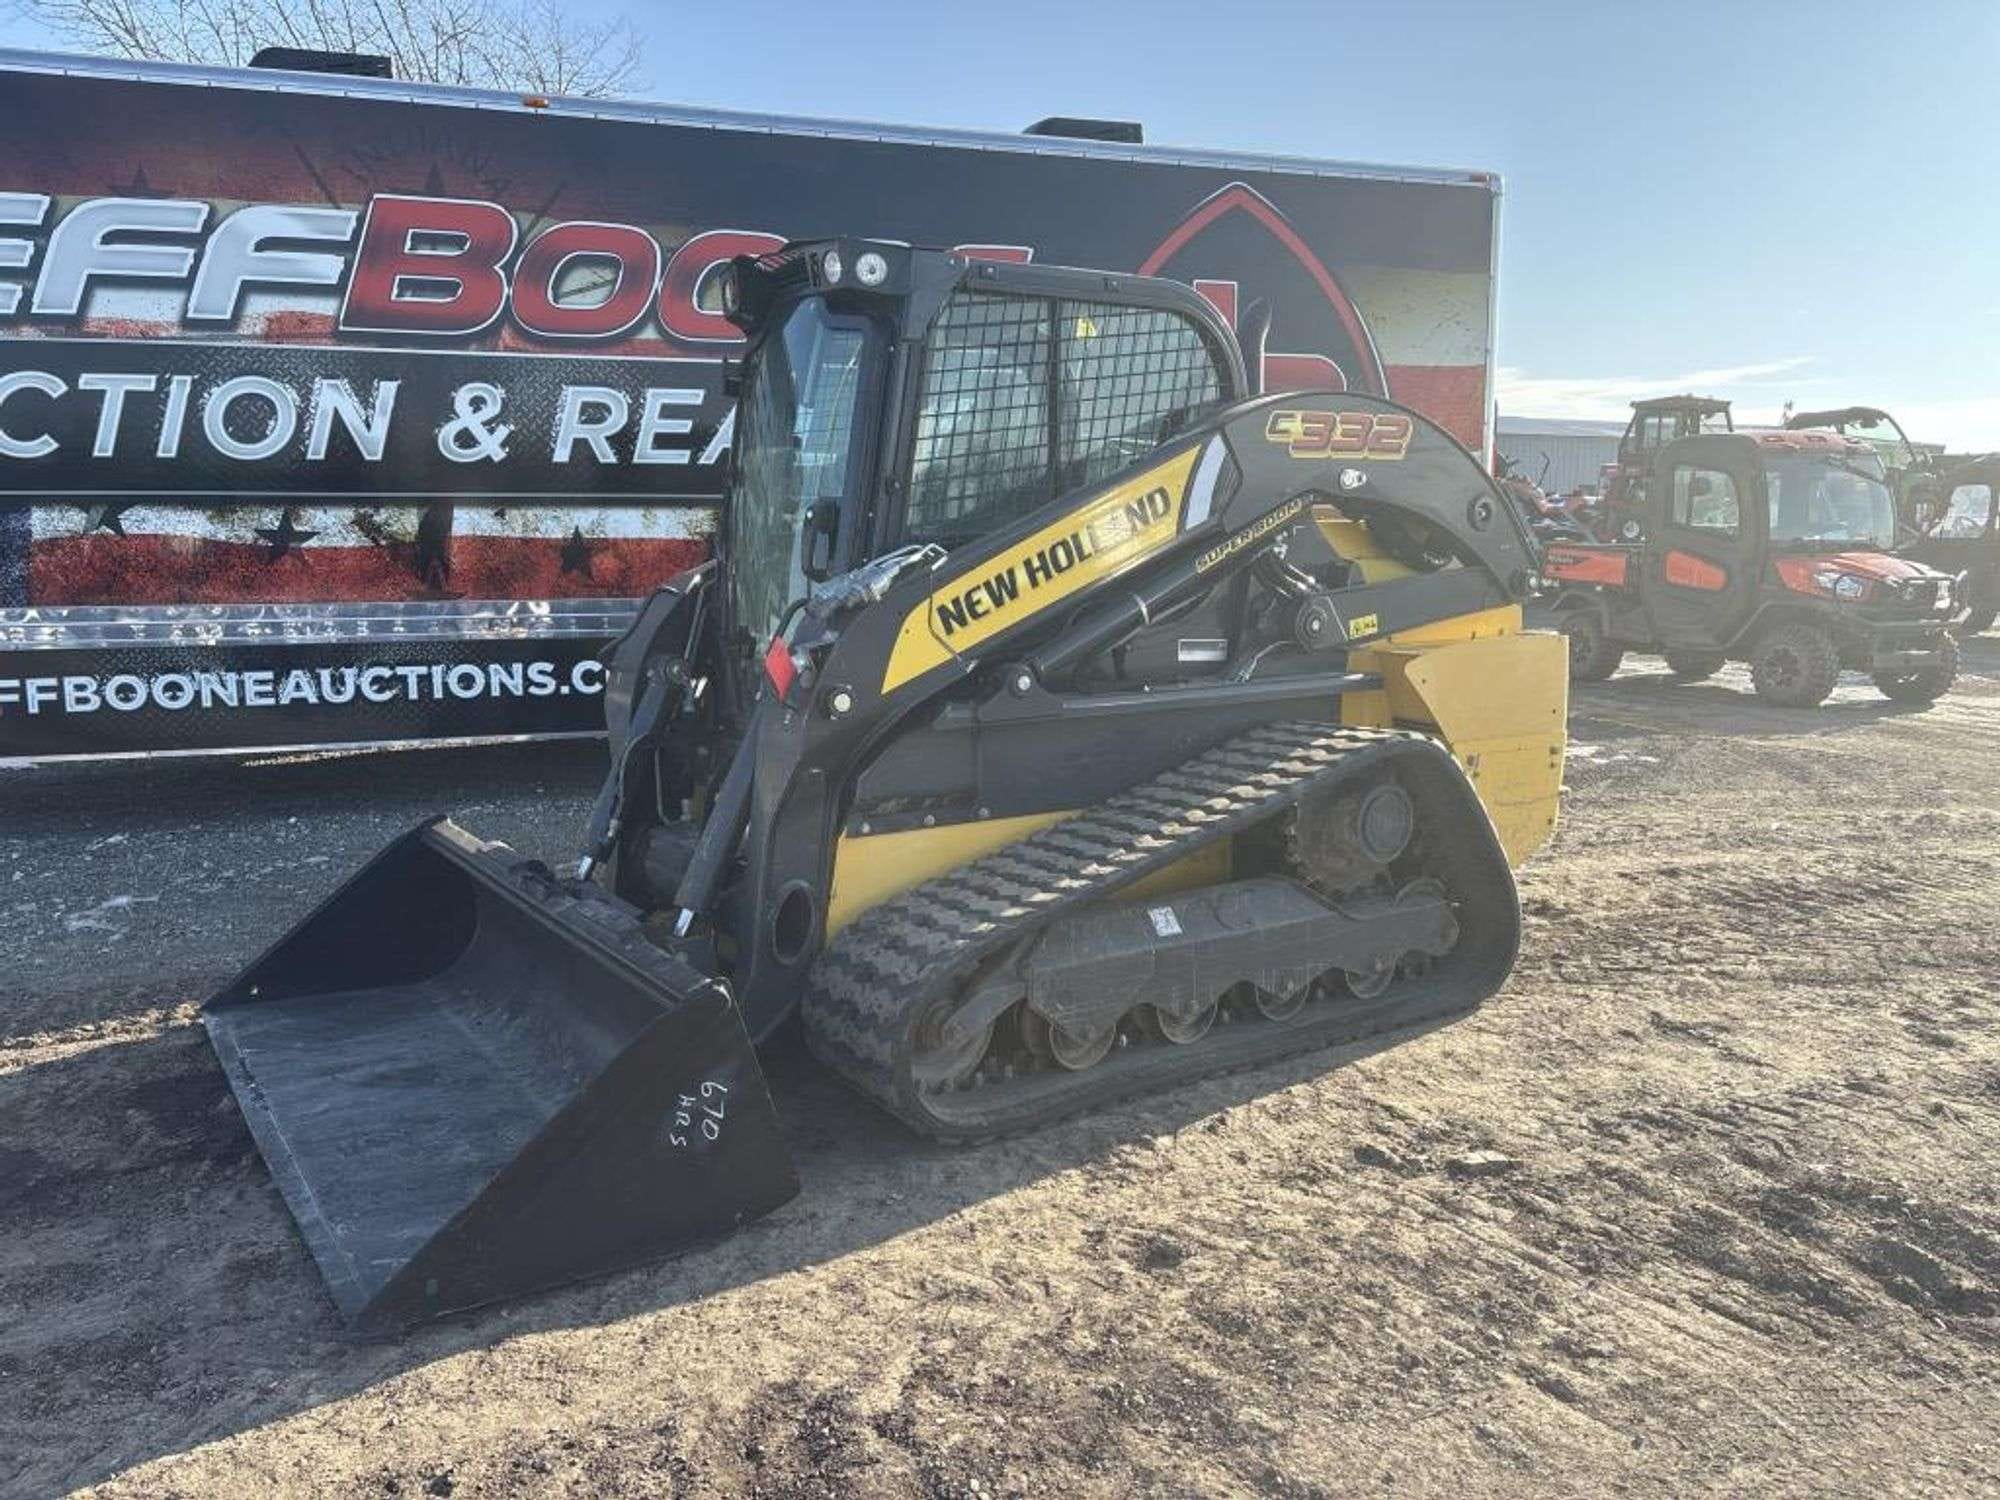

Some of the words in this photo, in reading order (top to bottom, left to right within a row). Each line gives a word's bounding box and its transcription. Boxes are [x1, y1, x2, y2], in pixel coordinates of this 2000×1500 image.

[437, 383, 512, 462] &
[936, 566, 1019, 636] NEW
[1023, 486, 1171, 590] HOLND
[0, 660, 610, 714] FBOONEAUCTIONS.C
[700, 1081, 728, 1140] 670
